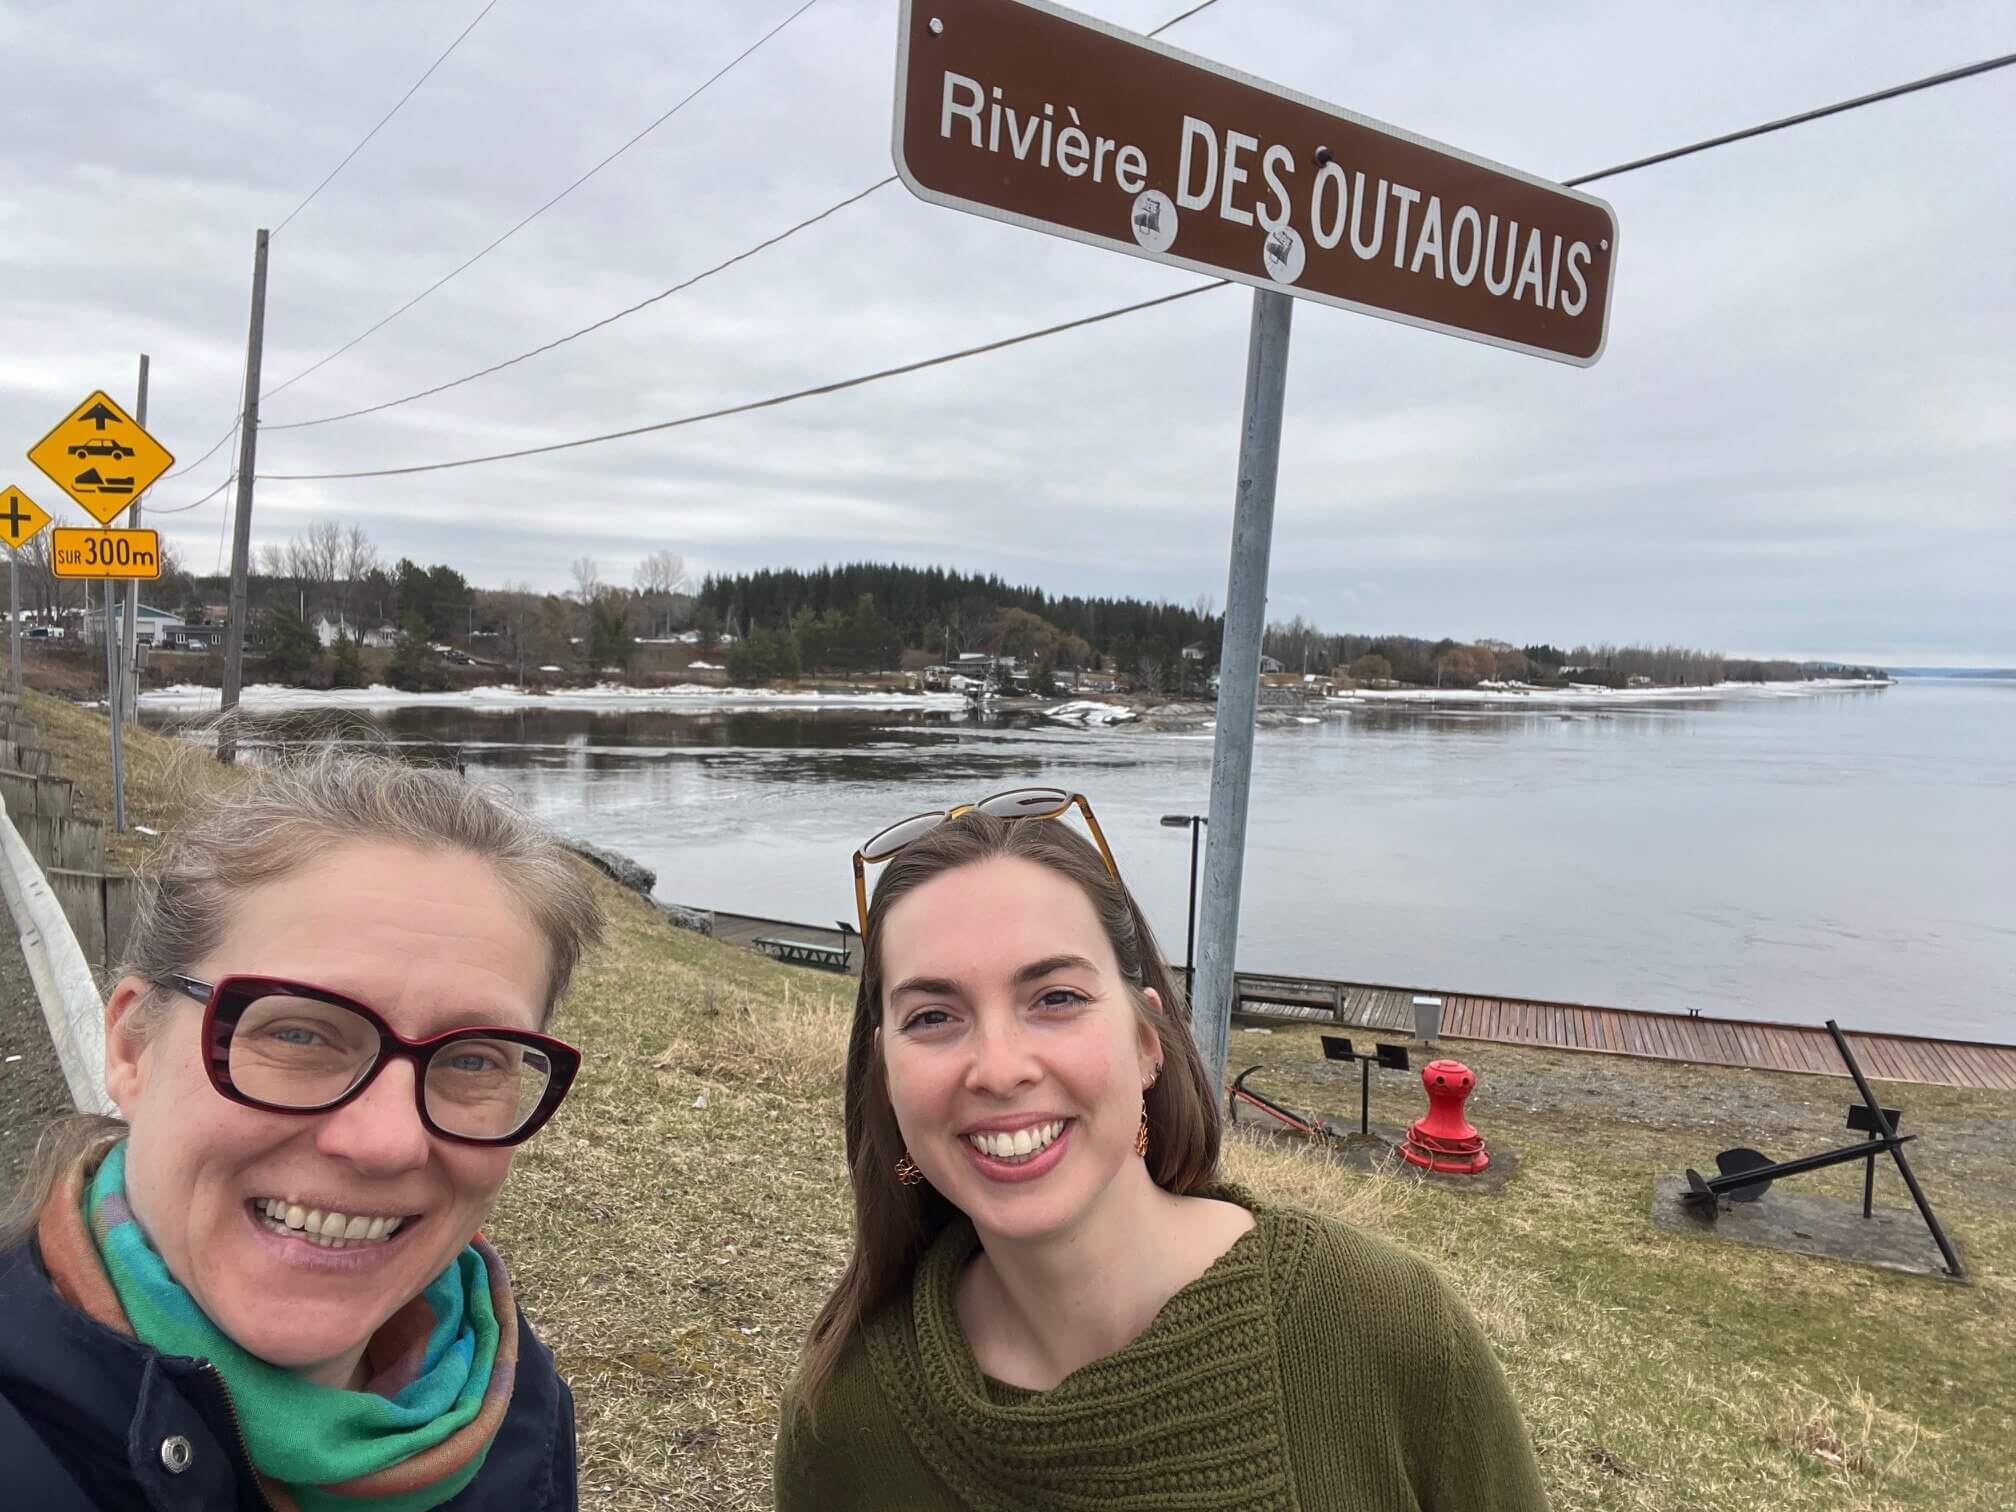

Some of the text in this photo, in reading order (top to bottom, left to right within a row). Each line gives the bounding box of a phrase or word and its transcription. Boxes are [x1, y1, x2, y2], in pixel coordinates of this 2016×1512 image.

[940, 70, 1593, 317] Rivière DES OUTAOUAIS
[58, 549, 81, 565] SUR
